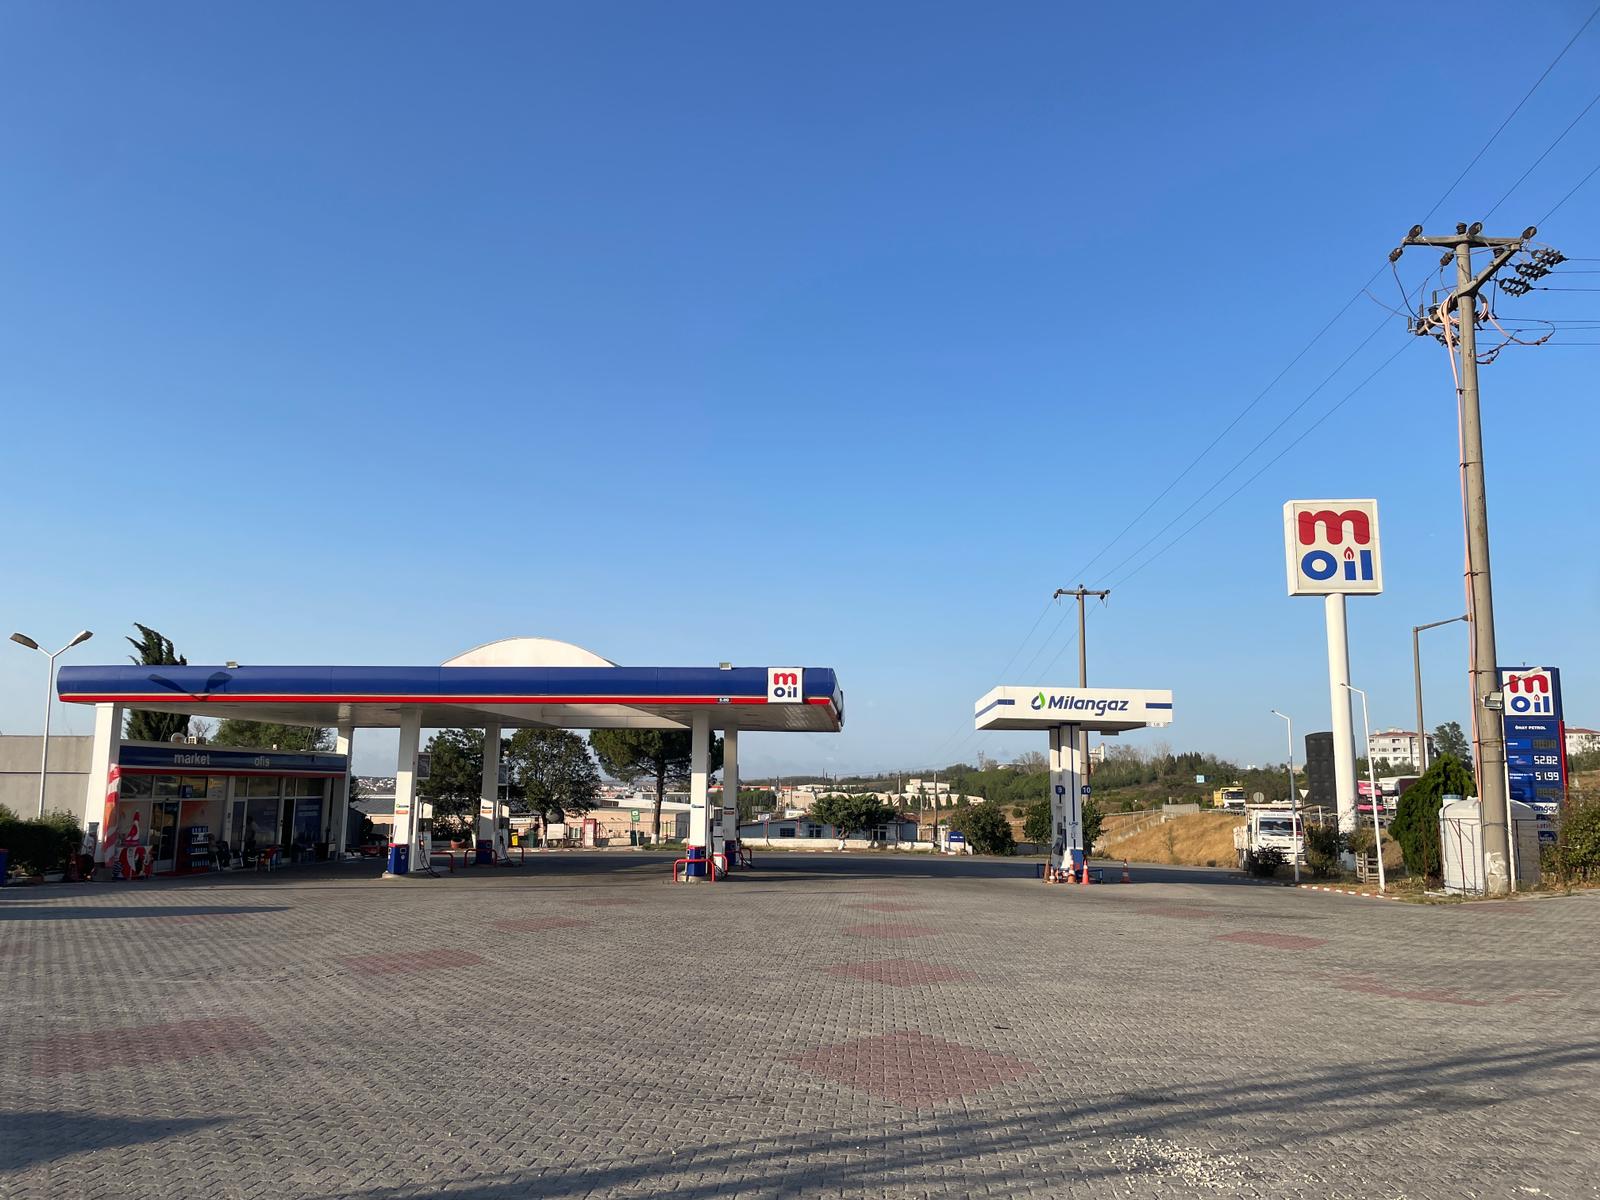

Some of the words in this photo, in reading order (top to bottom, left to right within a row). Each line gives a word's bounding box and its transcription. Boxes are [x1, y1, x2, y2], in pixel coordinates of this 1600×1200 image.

[1298, 509, 1371, 546] m
[1301, 546, 1374, 581] oil
[773, 672, 798, 685] m
[1508, 674, 1549, 693] m
[773, 685, 798, 698] oil
[1048, 695, 1129, 717] Milangaz
[1510, 694, 1551, 713] oil
[174, 753, 210, 765] market
[254, 755, 270, 768] ofis
